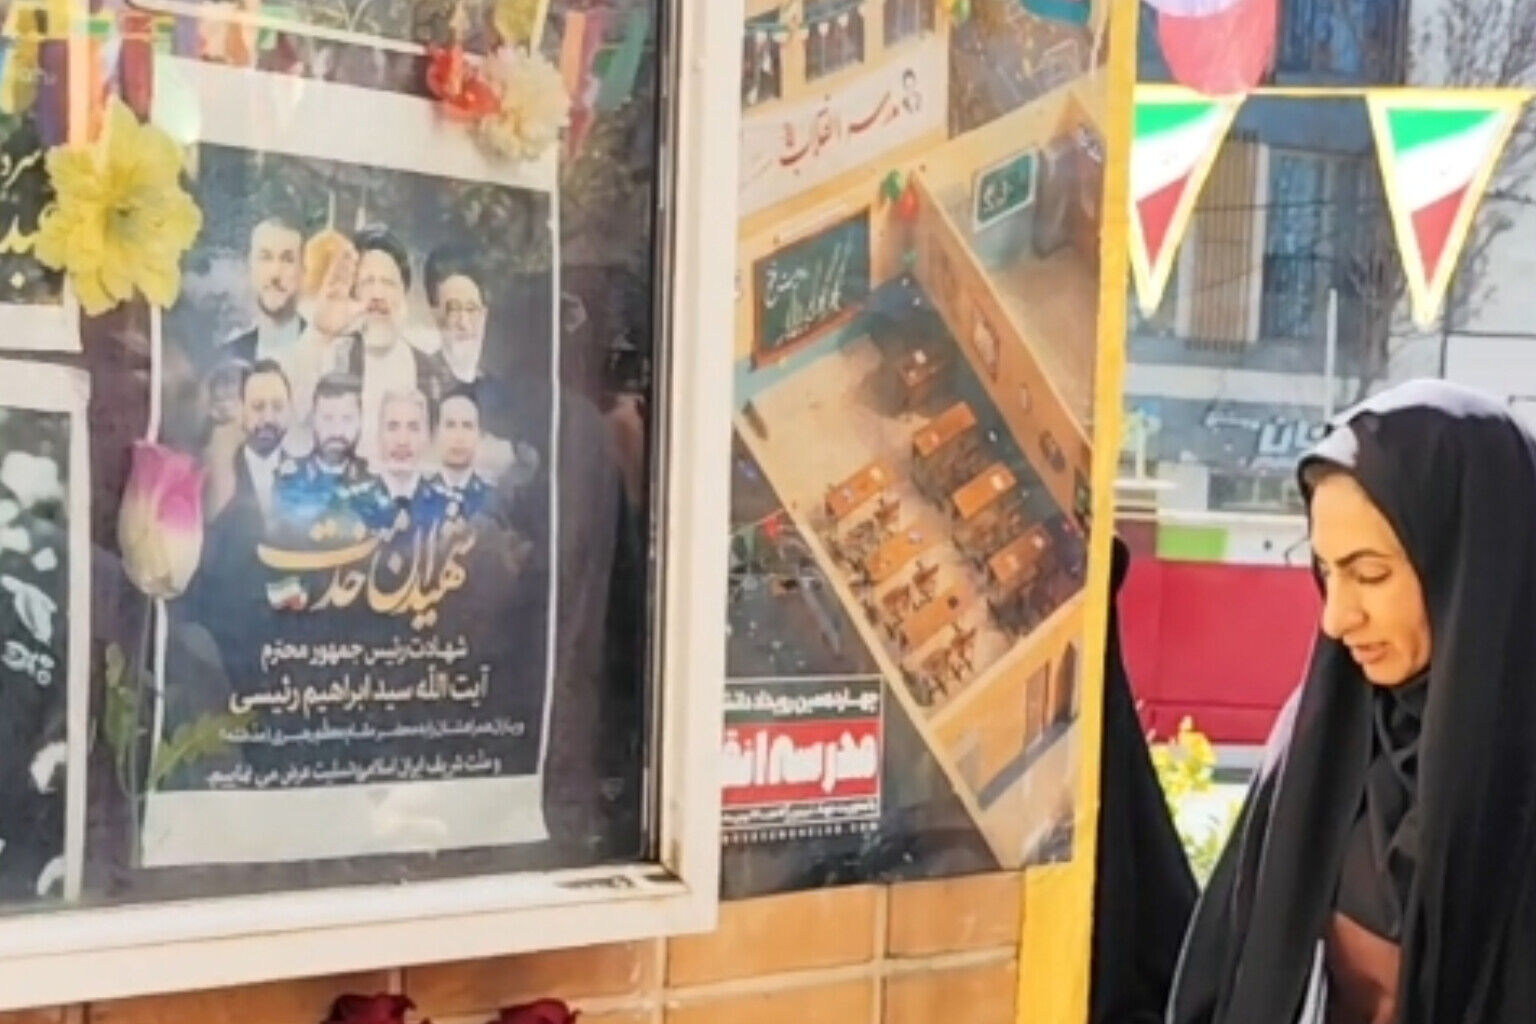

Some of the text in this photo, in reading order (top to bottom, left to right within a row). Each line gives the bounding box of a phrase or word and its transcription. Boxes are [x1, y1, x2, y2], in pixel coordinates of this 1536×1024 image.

[257, 501, 476, 631] شهیدان خدمت
[261, 638, 308, 674] محترم
[407, 635, 468, 665] شهادت
[302, 673, 371, 719] ابراهیم
[373, 679, 413, 711] سید
